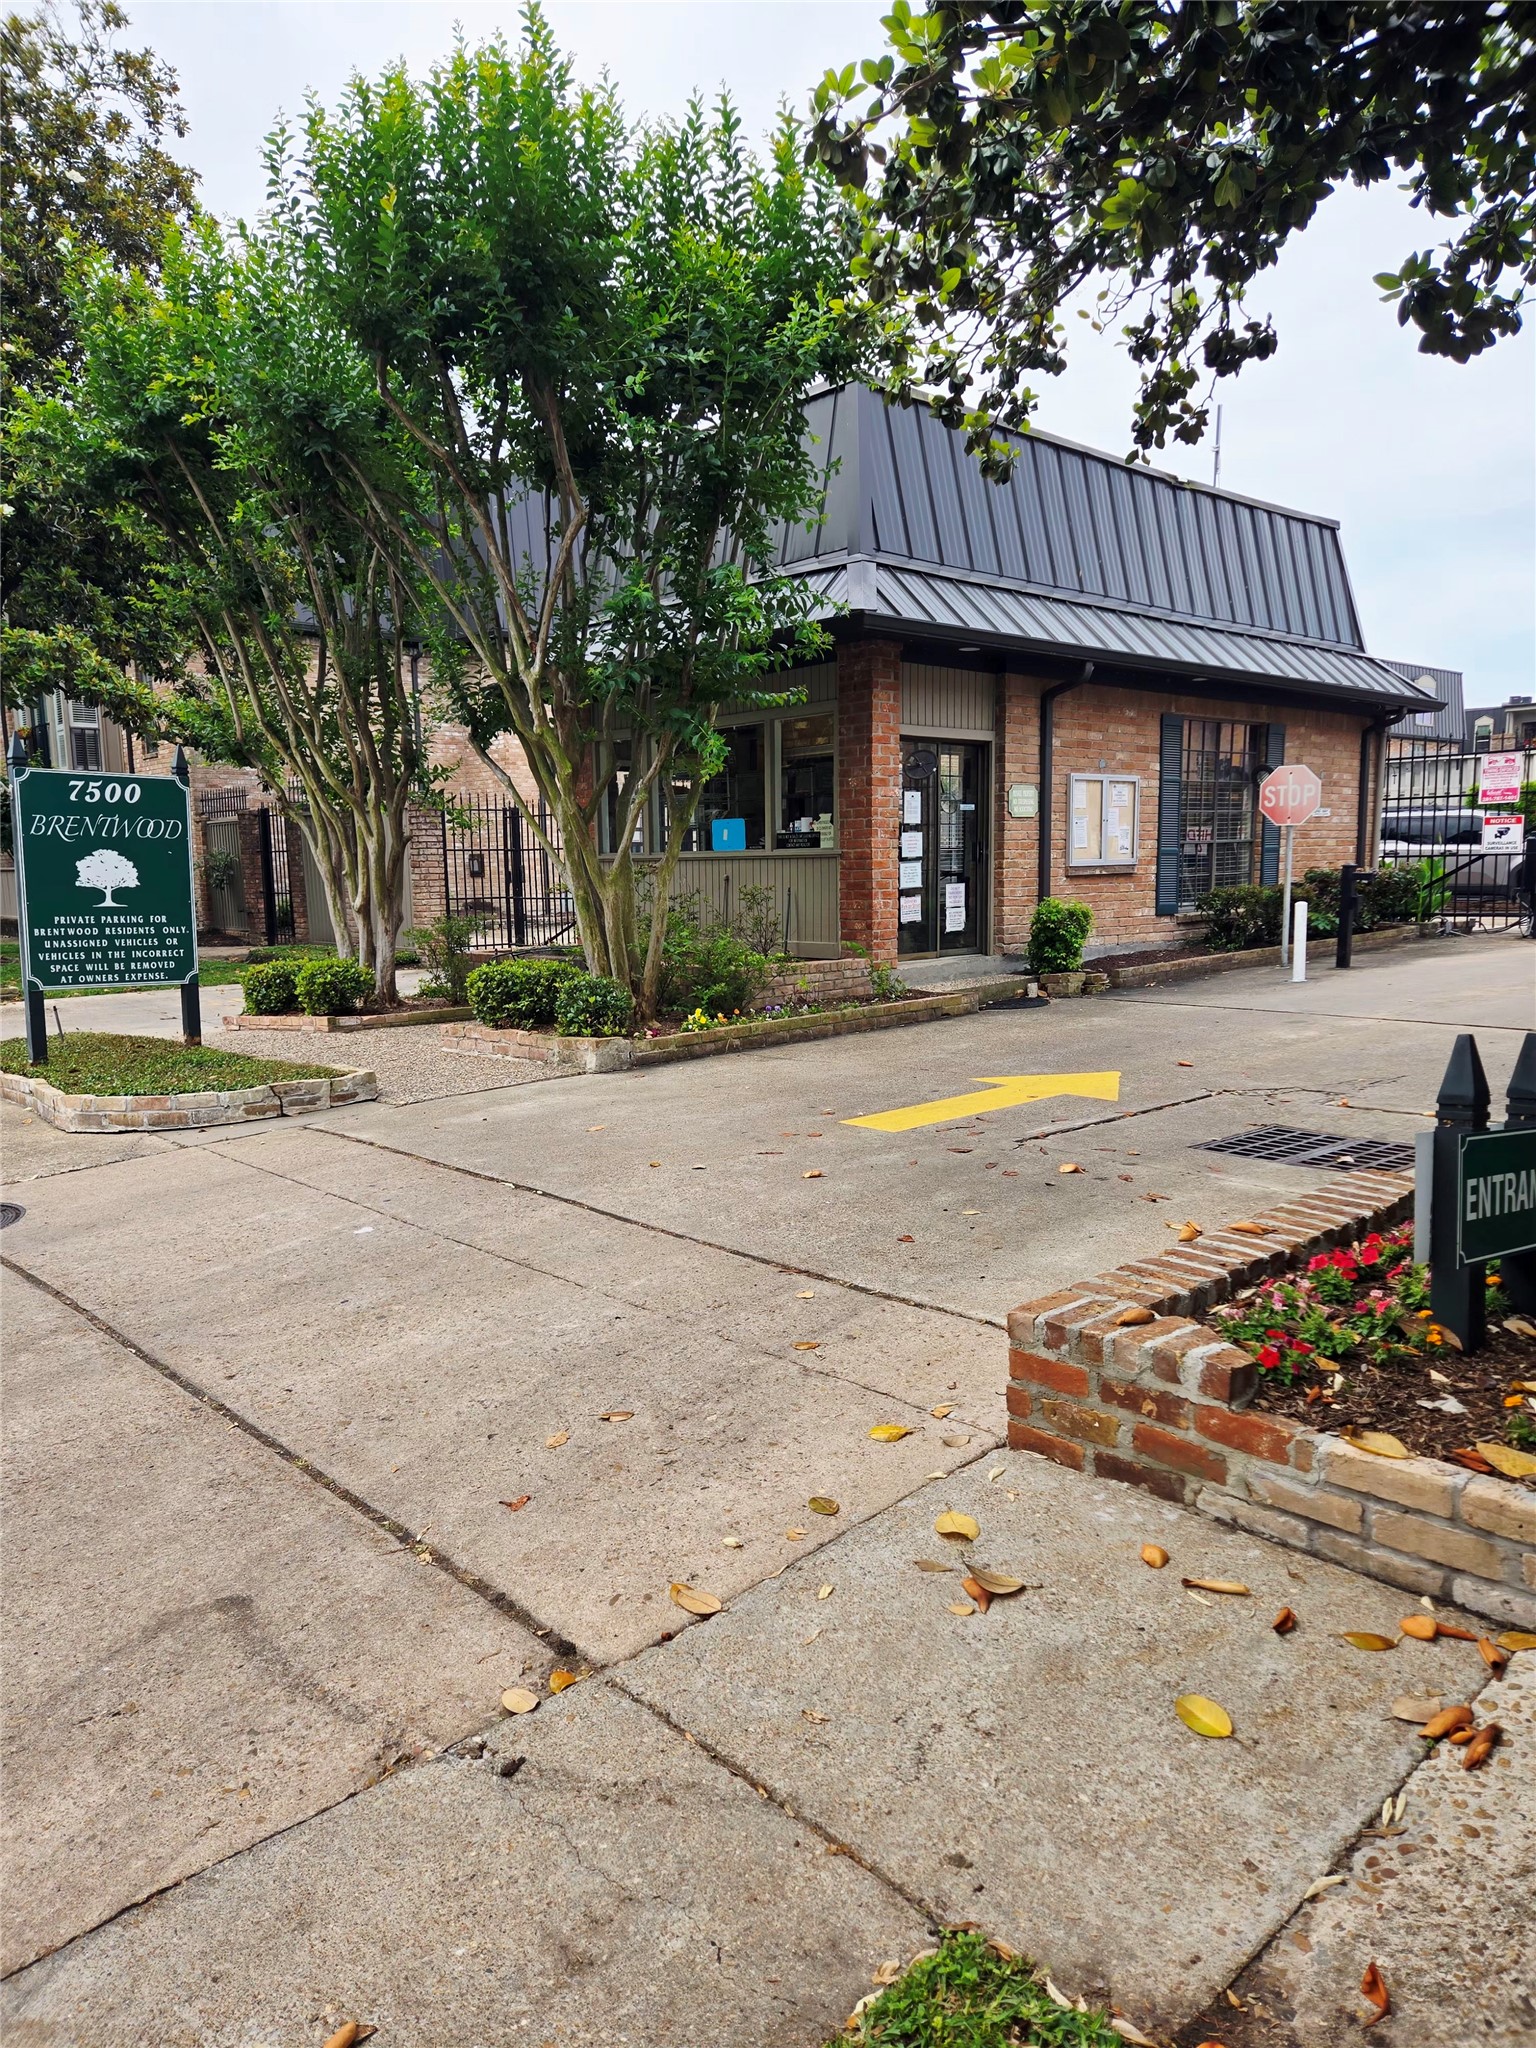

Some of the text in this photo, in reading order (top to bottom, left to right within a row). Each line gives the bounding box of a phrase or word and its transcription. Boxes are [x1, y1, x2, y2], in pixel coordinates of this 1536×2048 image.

[68, 780, 141, 804] 7500
[1264, 783, 1315, 808] STOP
[30, 814, 182, 842] BRENTWOOD
[54, 915, 167, 925] PRIVATE PARKING FOR
[34, 926, 190, 937] BRENTWOOD RESIDENTS ONLY.
[44, 938, 179, 949] UNASSIGNED VEHICLES OR
[38, 949, 185, 961] VEHICLES IN THE INCORRECT
[50, 961, 175, 973] SPACE WILL BE REMOVED
[60, 972, 169, 984] AT OWNERS EXPENSE.
